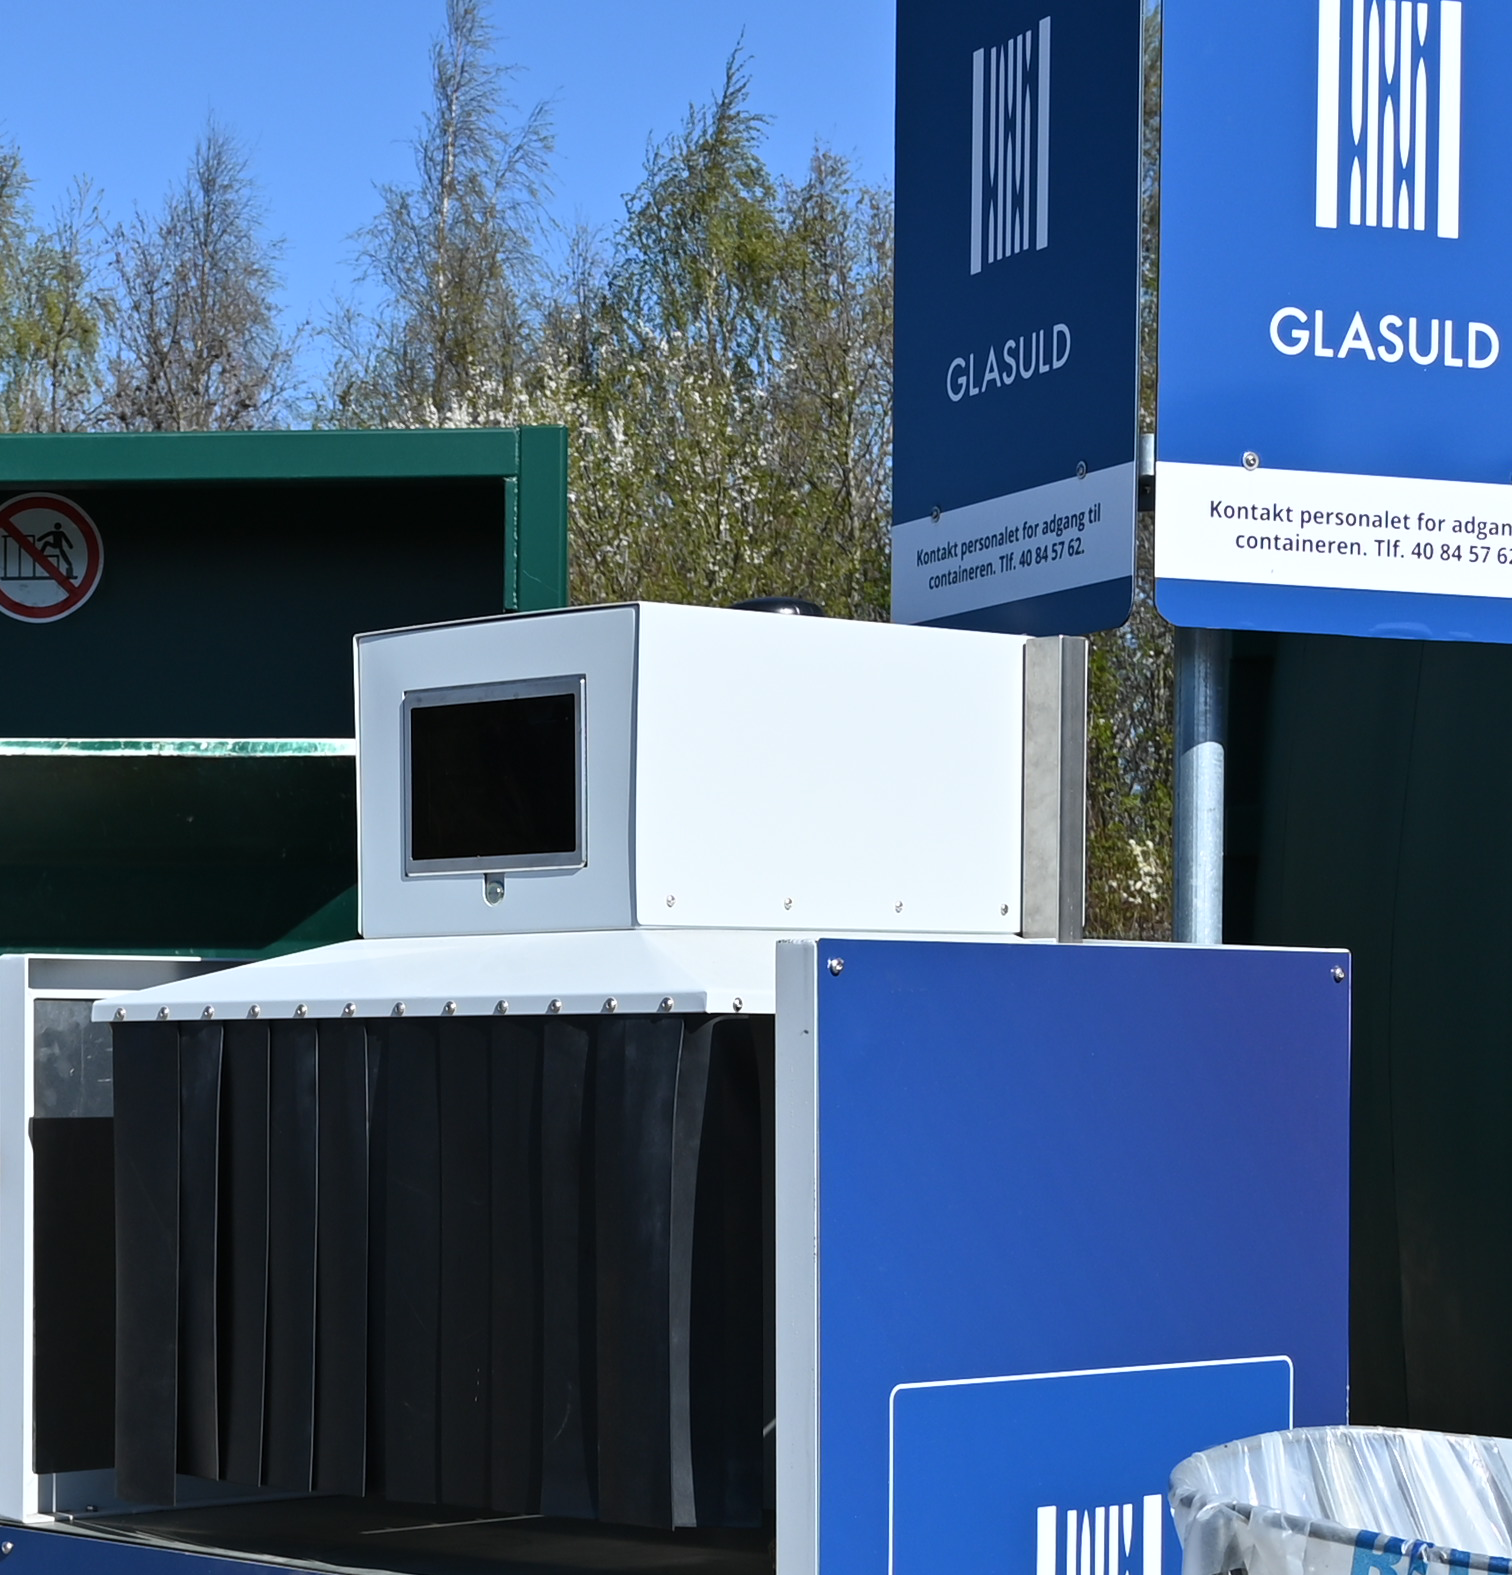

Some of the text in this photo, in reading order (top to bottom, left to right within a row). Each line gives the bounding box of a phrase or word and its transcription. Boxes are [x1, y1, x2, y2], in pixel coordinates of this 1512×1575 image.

[946, 322, 1071, 402] GLASULD
[1269, 306, 1500, 370] GLASULD
[916, 502, 1101, 567] Kontakt personalet for adgang til
[1210, 500, 1293, 523] Kontakt
[1300, 510, 1410, 529] personalet
[1417, 513, 1445, 533] for
[928, 537, 1085, 590] containeren. Tlf. 40 84 57 62.
[1235, 533, 1367, 556] containeren.
[1374, 539, 1404, 559] Tlf.
[1411, 542, 1434, 560] 40
[1440, 544, 1462, 562] 84
[1469, 546, 1490, 564] 57
